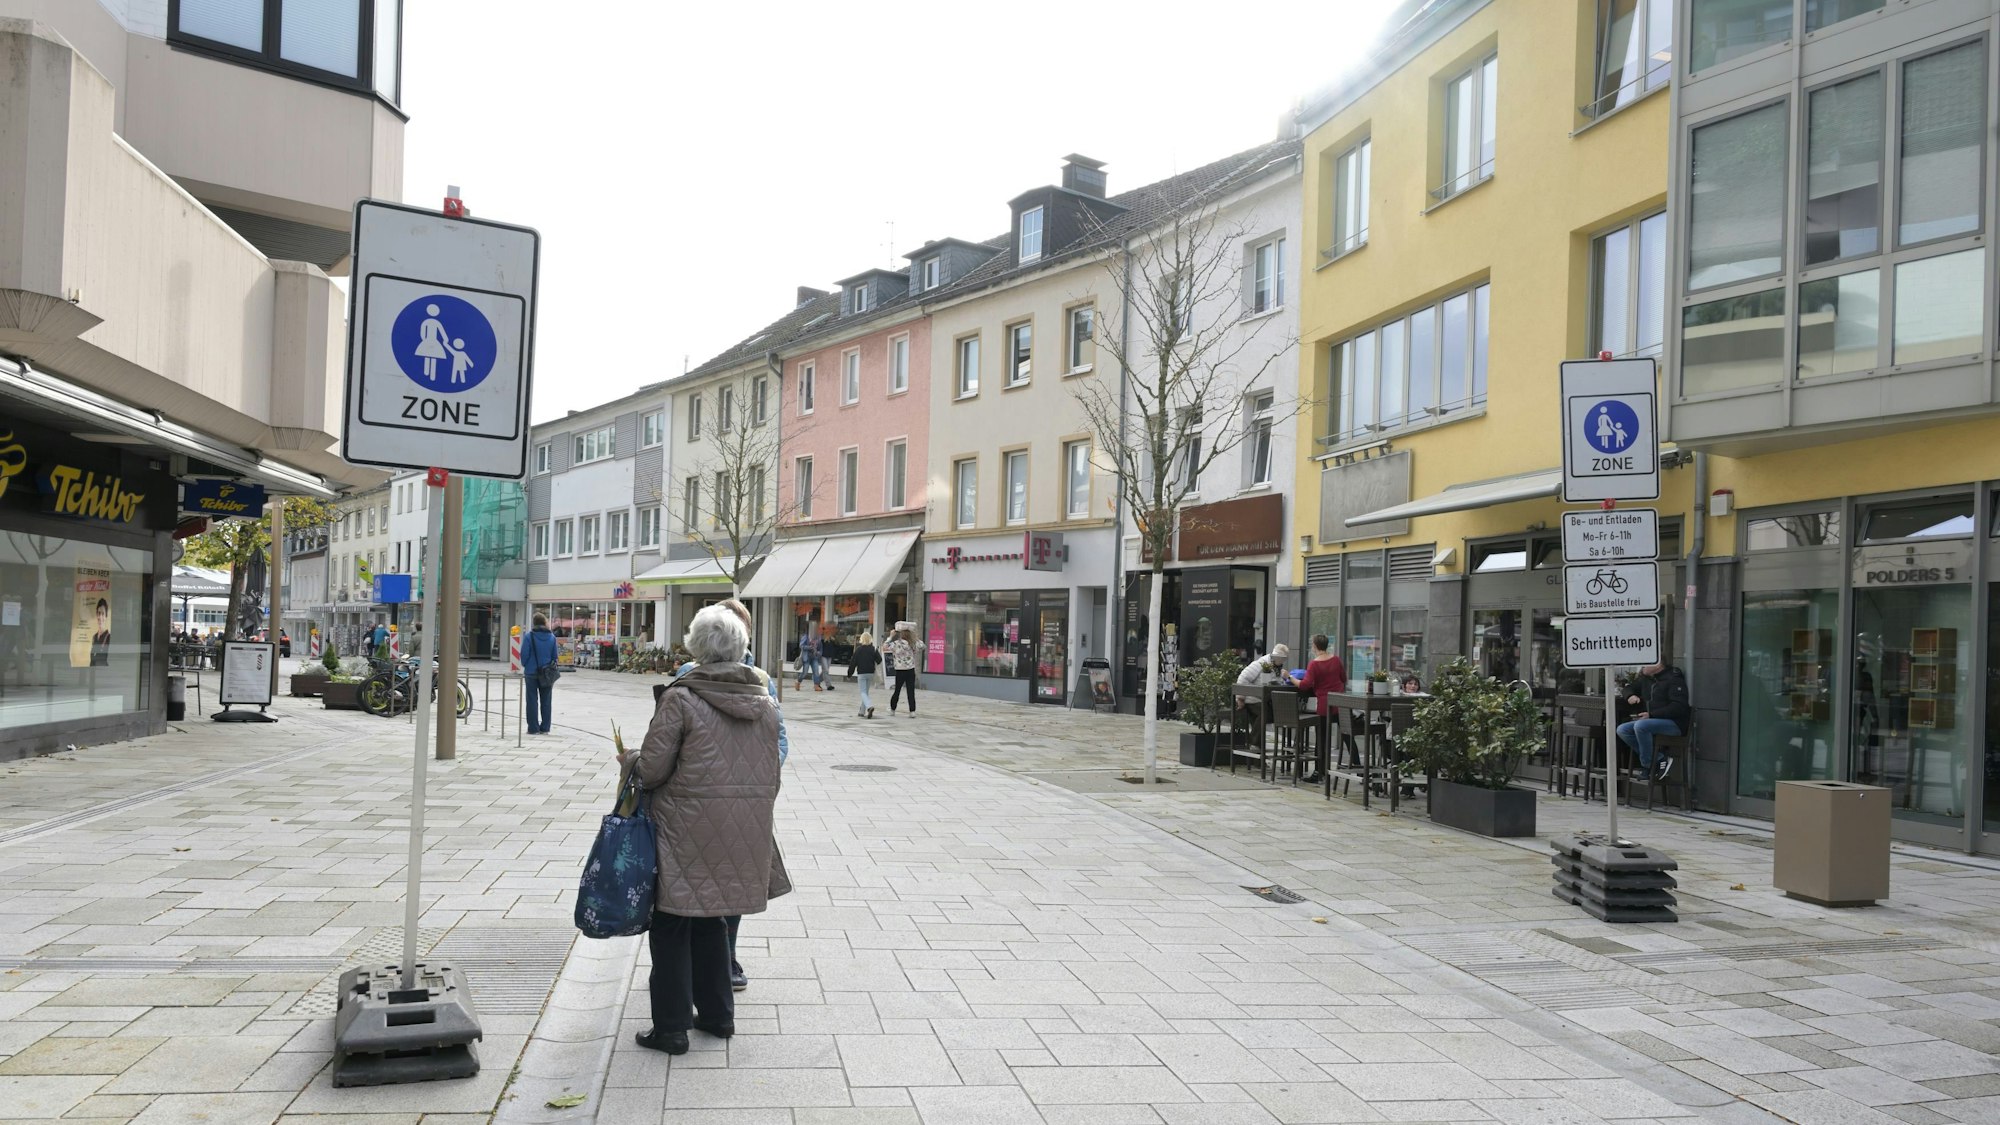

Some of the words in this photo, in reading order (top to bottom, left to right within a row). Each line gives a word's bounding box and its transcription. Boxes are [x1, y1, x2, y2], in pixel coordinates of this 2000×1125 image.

[402, 395, 480, 426] ZONE
[1592, 457, 1634, 471] ZONE
[50, 465, 144, 523] Tchibo
[200, 497, 249, 512] Tchibo
[1571, 516, 1586, 526] Be-
[1588, 516, 1603, 526] und
[1606, 515, 1642, 525] Entladen
[1583, 532, 1607, 541] Mo-Fr
[1610, 531, 1632, 540] 6-11h
[1589, 547, 1599, 556] Sa
[1602, 546, 1625, 556] 6-10h
[1546, 575, 1563, 585] GL
[1866, 568, 1941, 584] POLDERS
[1944, 567, 1955, 581] 5
[1576, 600, 1587, 609] bis
[1589, 598, 1625, 608] Baustelle
[1627, 597, 1641, 607] frei
[1572, 636, 1652, 652] Schritttempo
